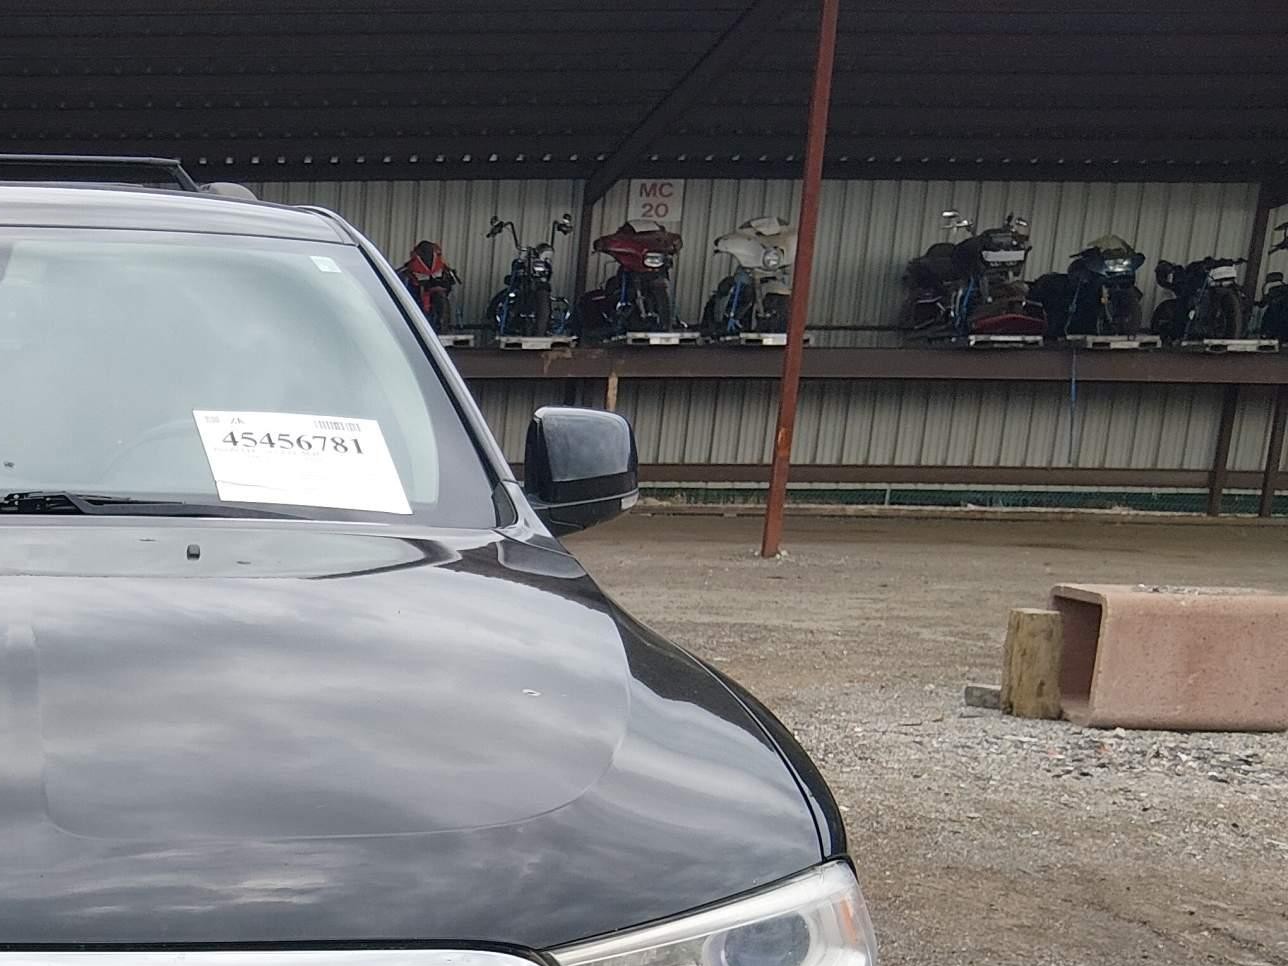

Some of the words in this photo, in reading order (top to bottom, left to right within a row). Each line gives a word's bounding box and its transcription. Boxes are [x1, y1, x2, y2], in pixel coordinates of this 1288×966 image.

[640, 182, 673, 198] MC
[641, 203, 669, 218] 20
[222, 431, 363, 454] 45456781
